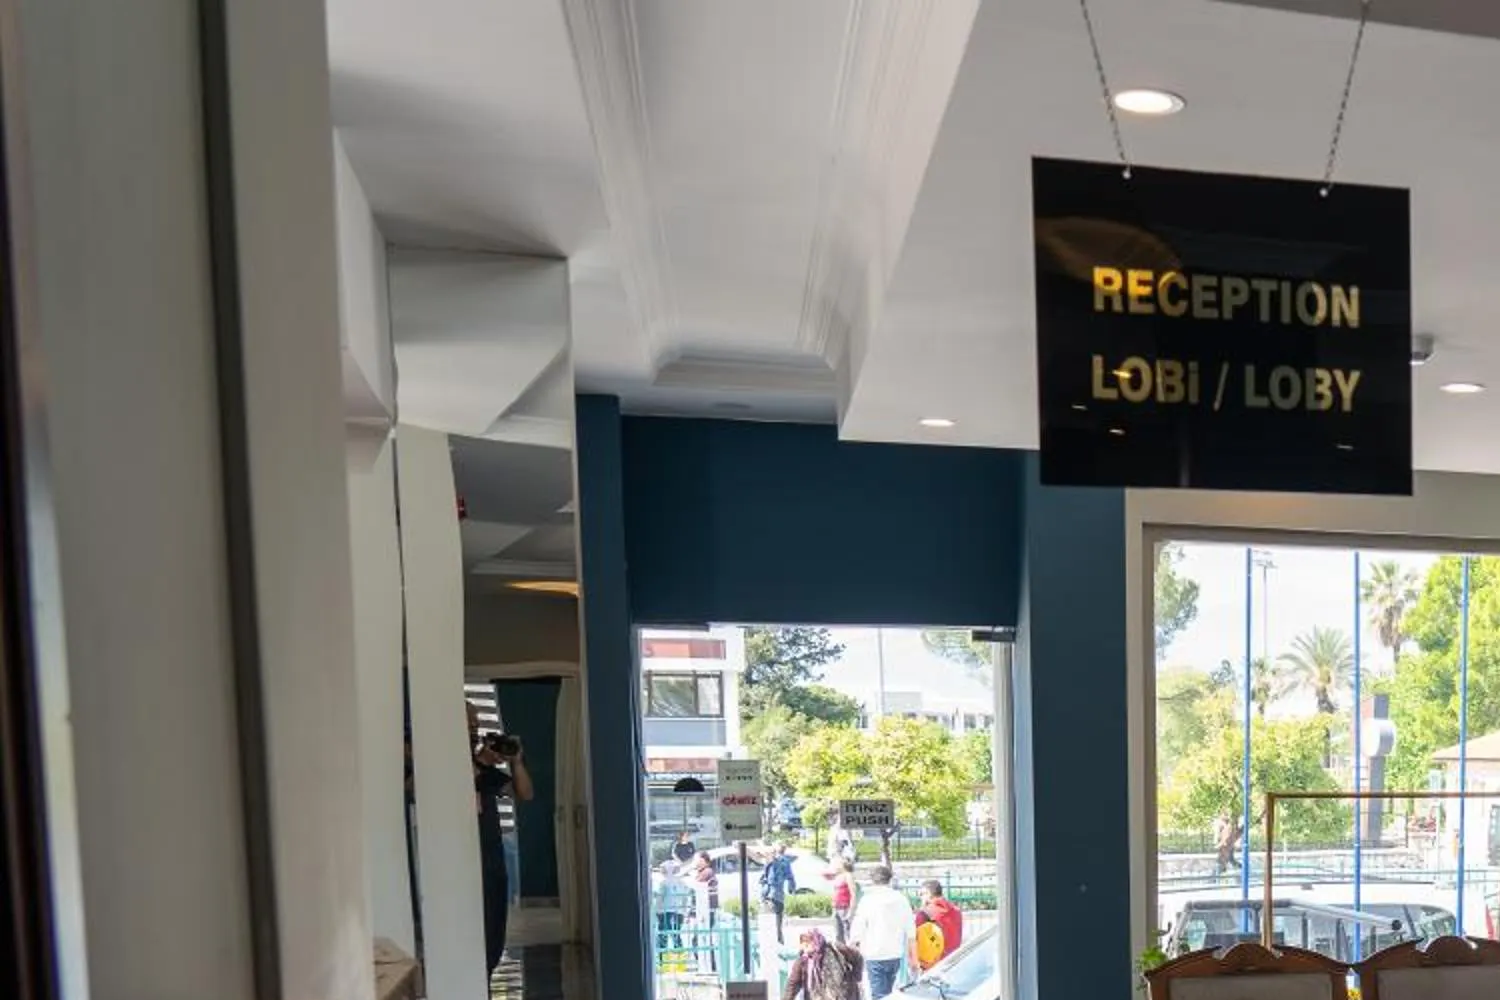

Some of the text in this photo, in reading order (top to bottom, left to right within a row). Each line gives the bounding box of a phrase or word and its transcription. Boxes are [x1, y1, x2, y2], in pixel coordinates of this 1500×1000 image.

[1092, 265, 1361, 328] RECEPTION
[1212, 361, 1230, 412] /
[1244, 364, 1362, 413] LOBY
[845, 815, 889, 824] PUSH
